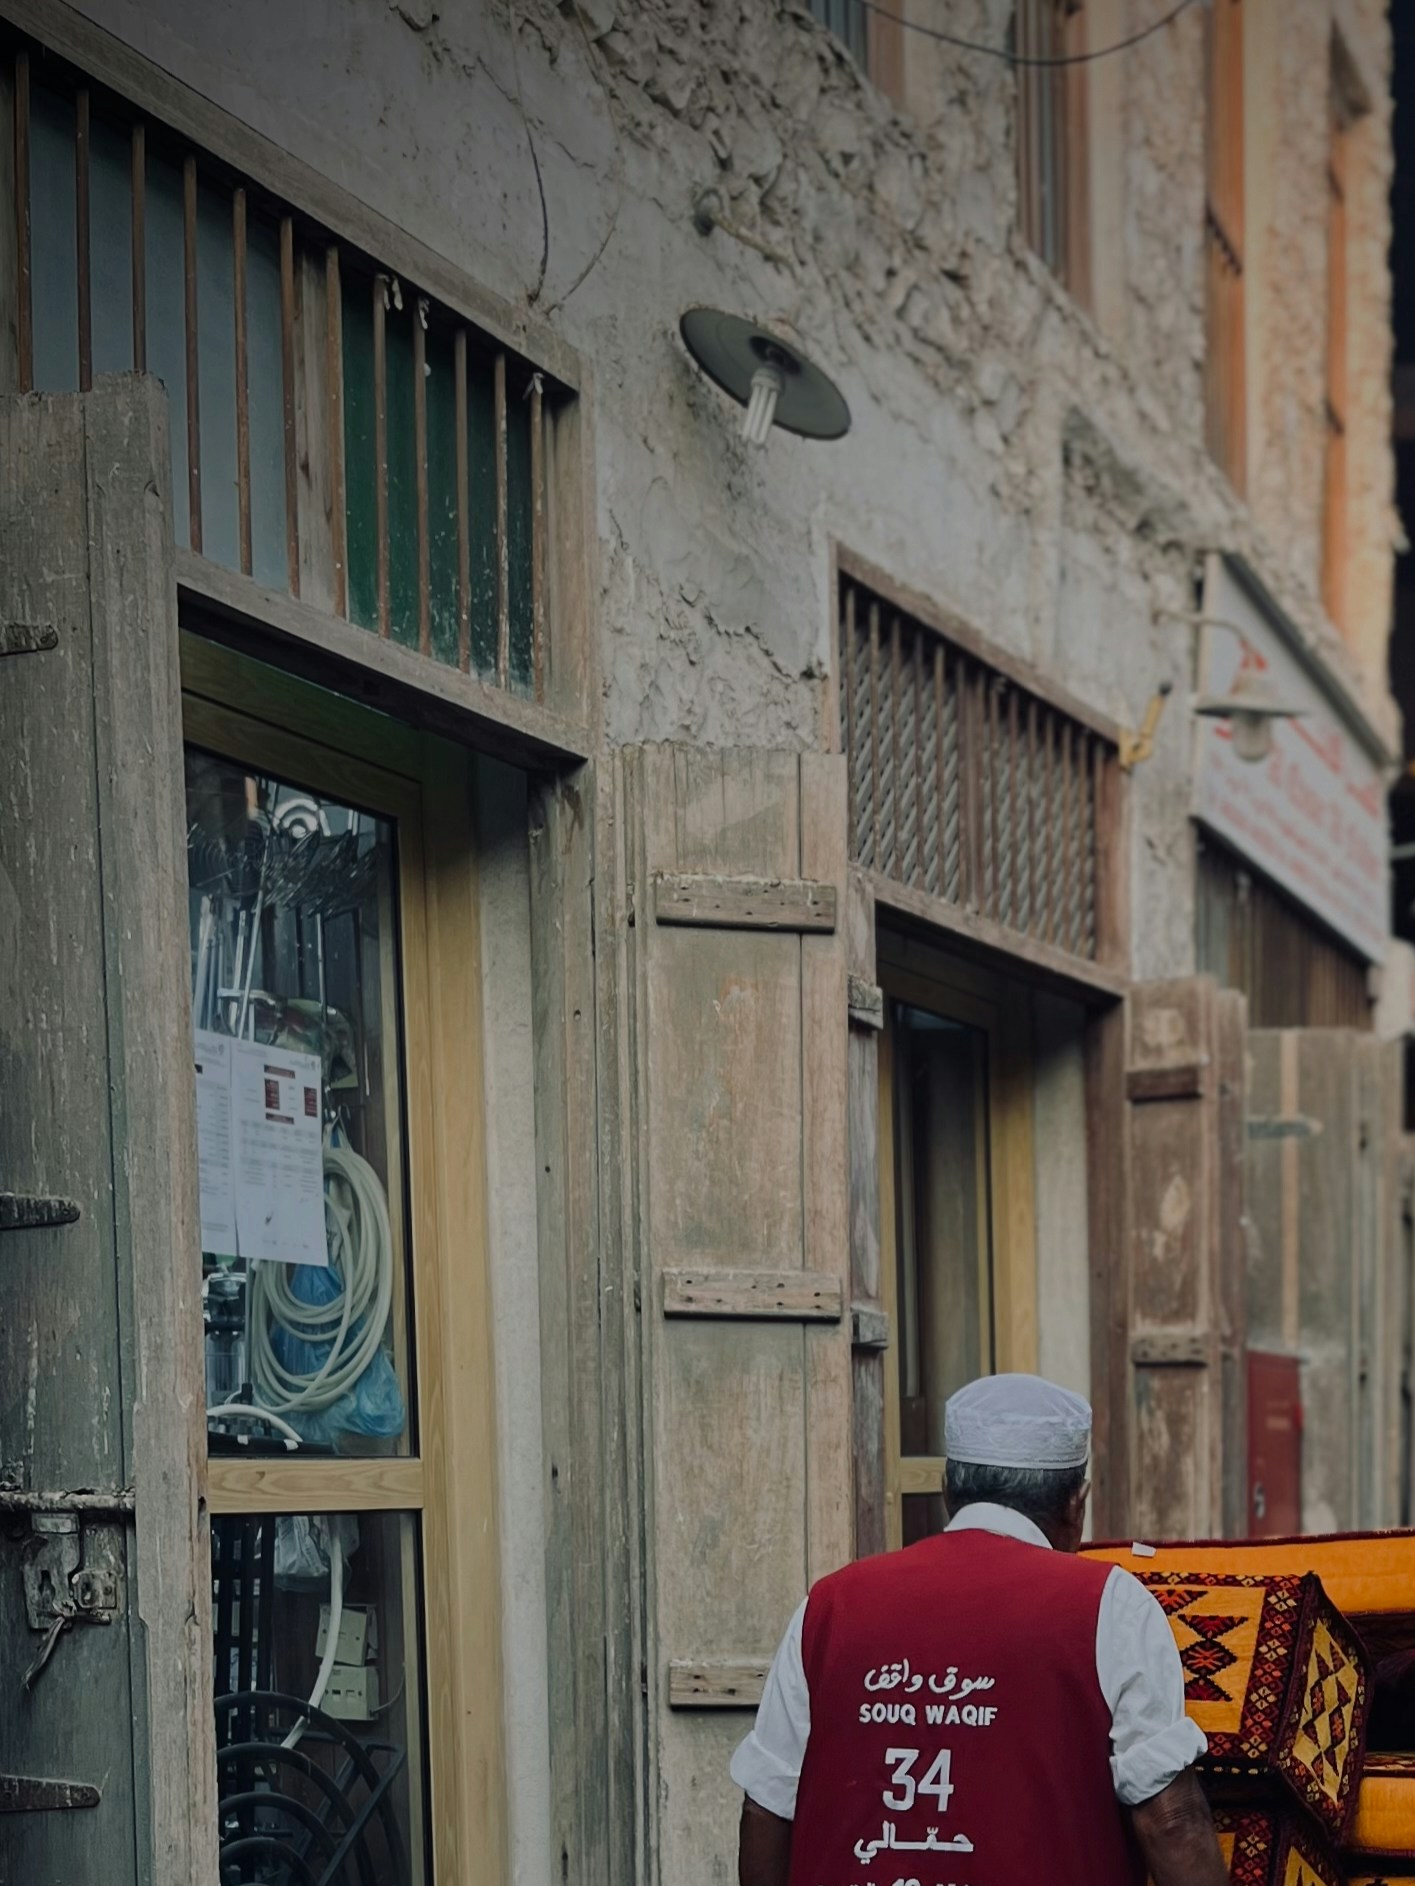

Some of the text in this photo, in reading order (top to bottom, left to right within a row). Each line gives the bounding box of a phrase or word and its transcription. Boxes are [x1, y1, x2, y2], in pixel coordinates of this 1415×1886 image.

[864, 1658, 995, 1700] سوق واقف
[859, 1702, 998, 1727] SOUQ WAQIF
[882, 1748, 954, 1812] 34
